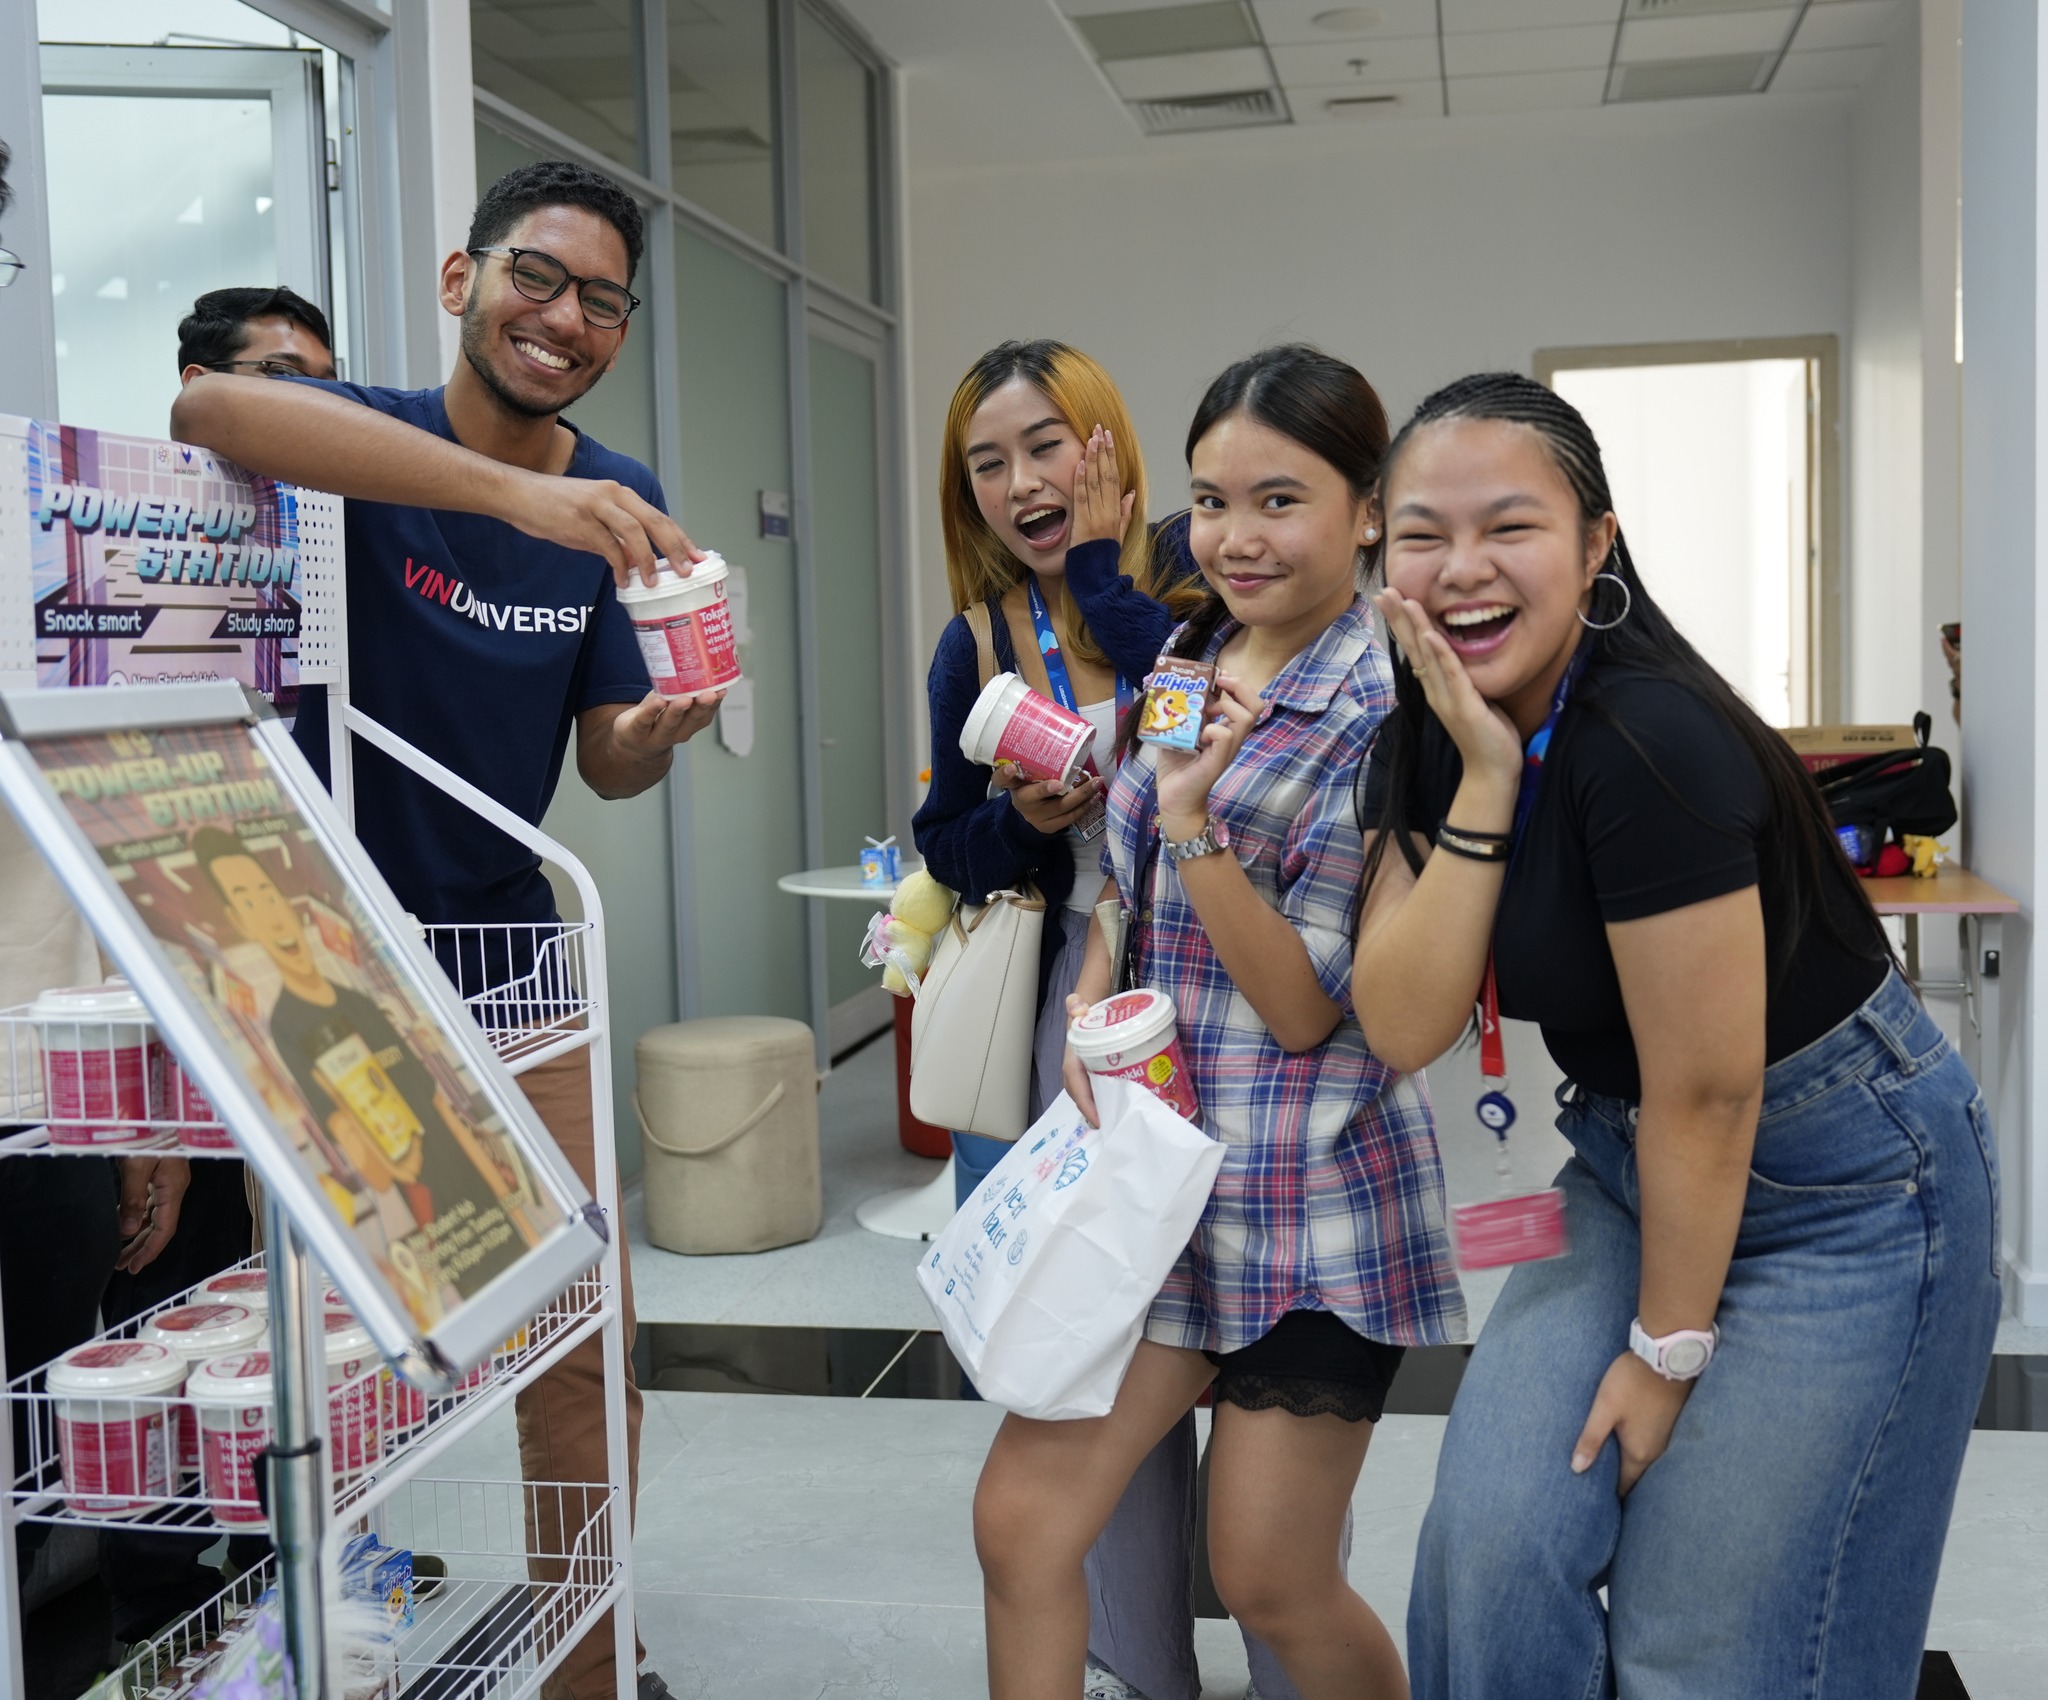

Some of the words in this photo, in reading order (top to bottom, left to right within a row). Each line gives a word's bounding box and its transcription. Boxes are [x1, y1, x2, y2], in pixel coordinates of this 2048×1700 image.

[38, 483, 256, 544] POWER-UP
[136, 538, 296, 590] STATION
[44, 608, 95, 633] Snack
[98, 610, 142, 632] smart
[227, 612, 262, 637] Study
[264, 613, 296, 637] sharp
[1171, 665, 1196, 676] Nucare
[42, 750, 225, 801] POWER-UP
[142, 777, 284, 828] STATION
